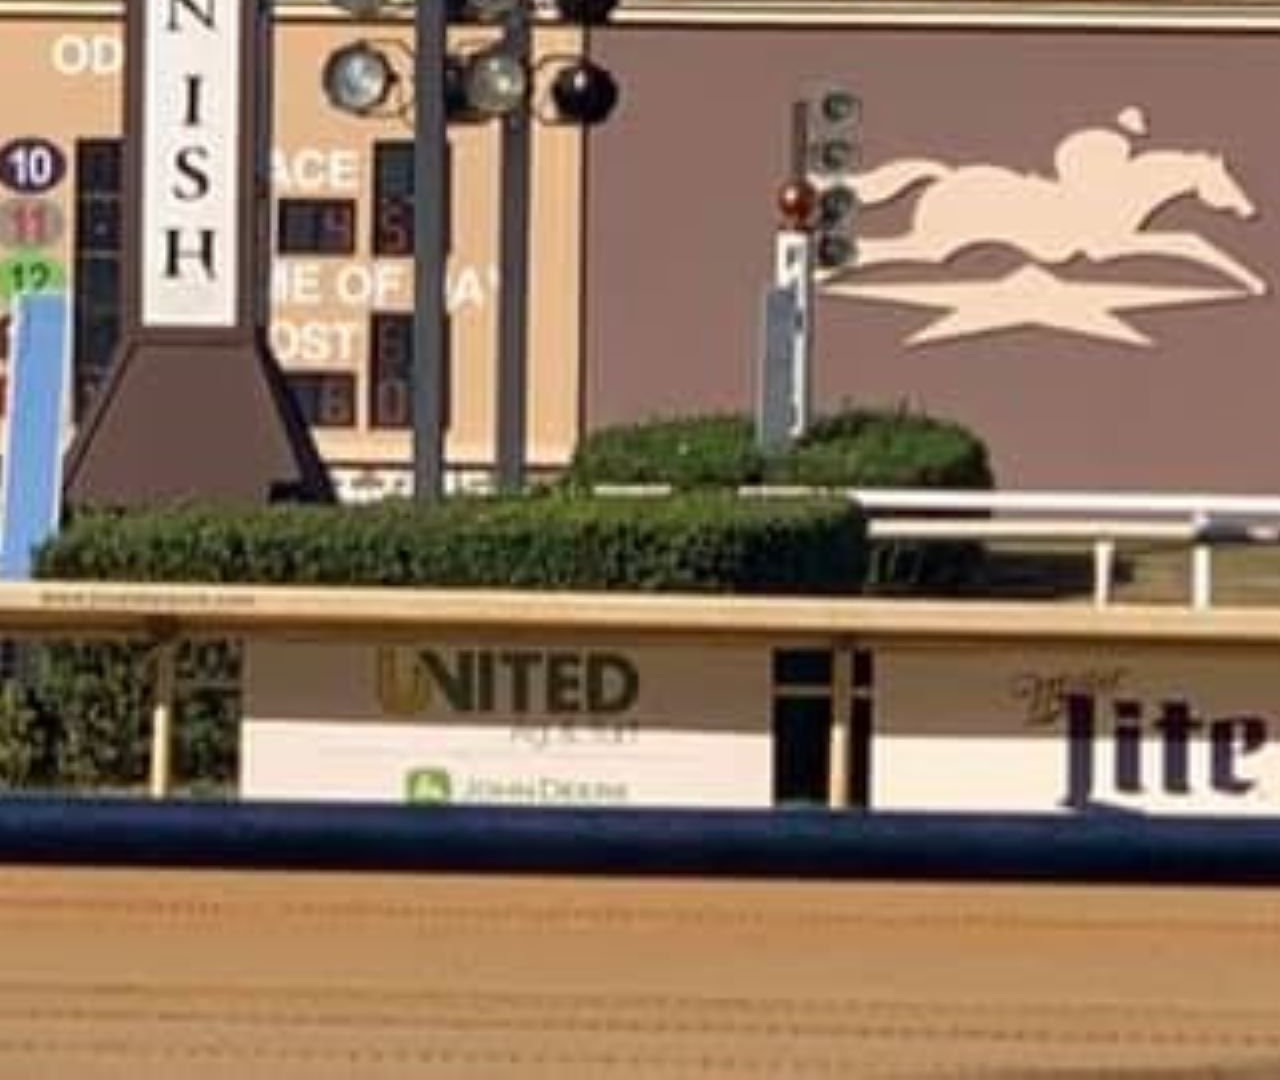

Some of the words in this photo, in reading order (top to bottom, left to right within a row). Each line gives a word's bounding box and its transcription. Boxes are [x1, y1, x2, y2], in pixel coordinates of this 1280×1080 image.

[7, 147, 53, 185] 10
[13, 207, 46, 240] 11
[337, 264, 404, 305] OF
[378, 647, 639, 713] UNITED
